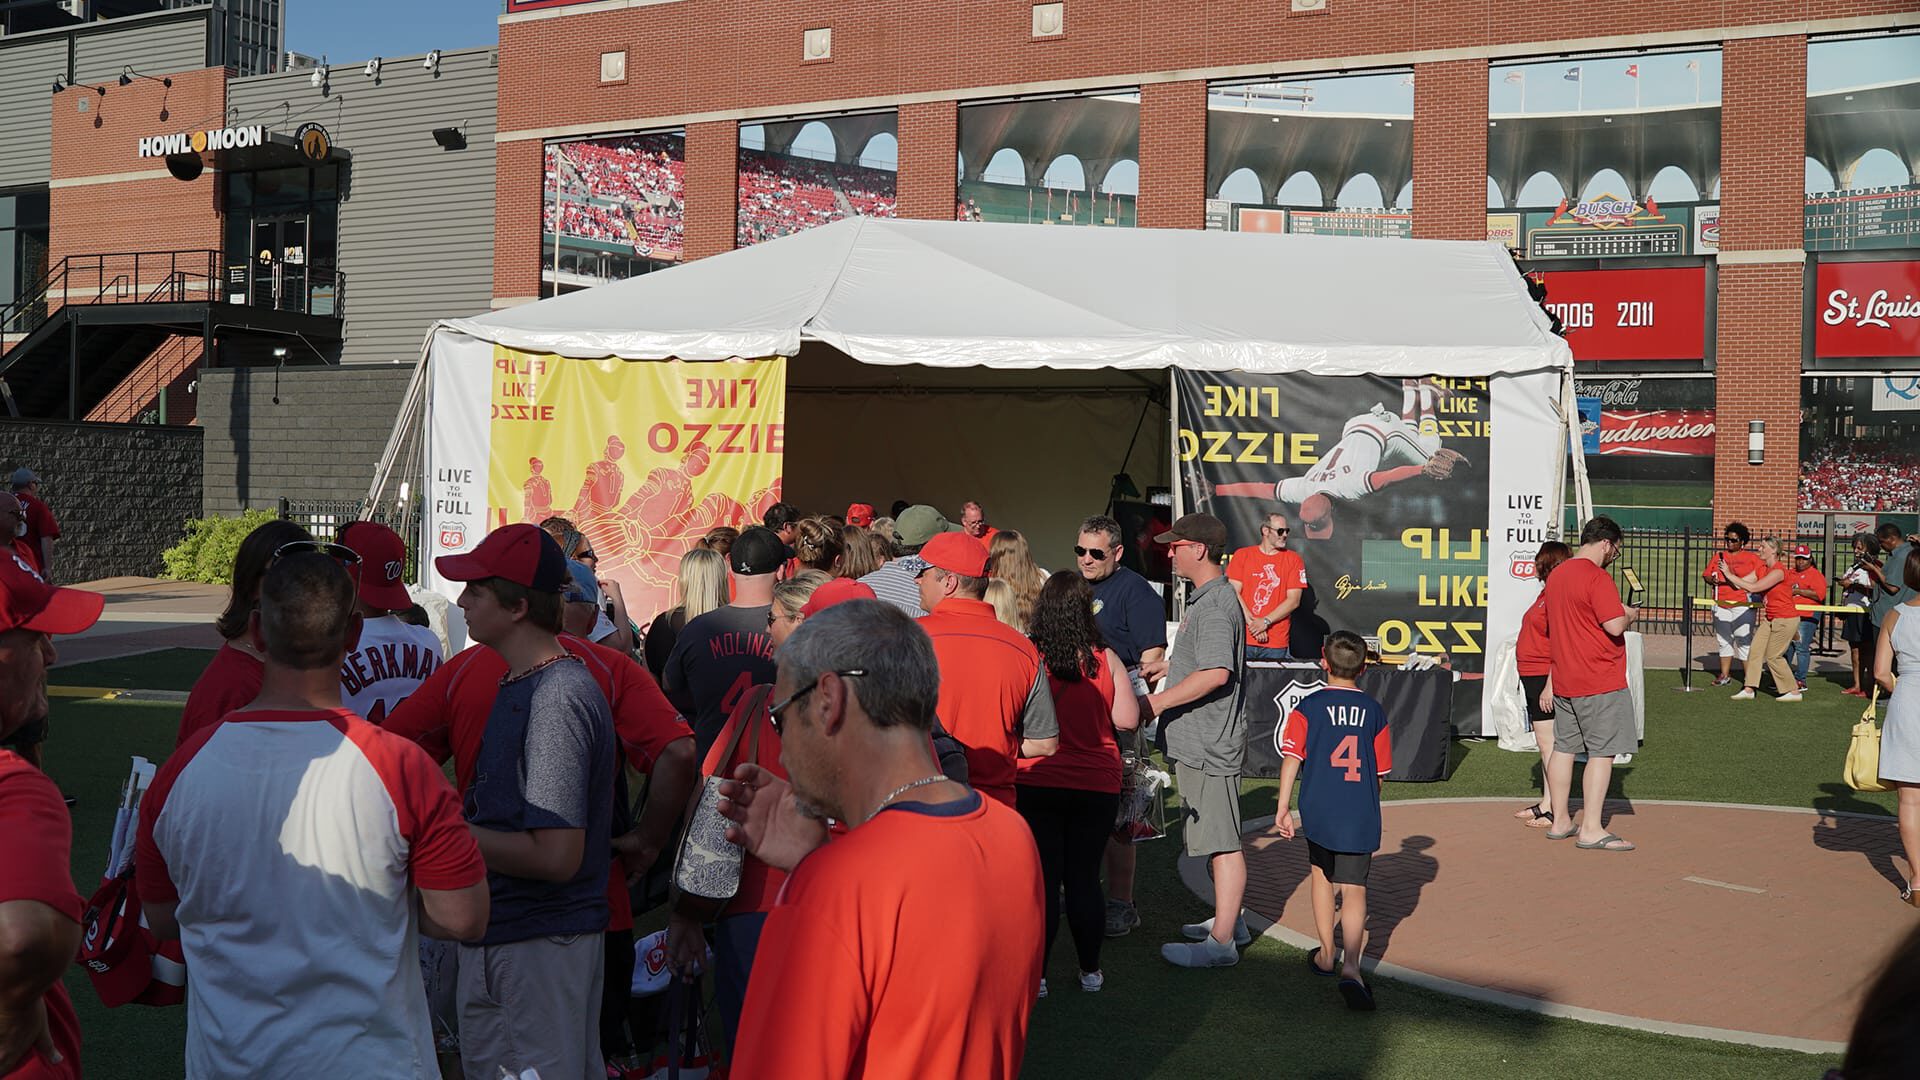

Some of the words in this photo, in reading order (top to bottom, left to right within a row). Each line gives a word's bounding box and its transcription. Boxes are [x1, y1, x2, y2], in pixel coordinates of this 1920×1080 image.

[138, 133, 191, 157] HOWL
[207, 125, 262, 150] MOON
[1807, 185, 1907, 200] NATIONAL
[1575, 201, 1637, 216] BUSCH
[1617, 301, 1654, 327] 2011
[502, 382, 537, 398] LIKE
[686, 378, 757, 409] LIKE
[1203, 385, 1280, 418] LIKE
[1440, 397, 1478, 413] LIKE
[647, 422, 785, 454] OZZIE
[1179, 428, 1320, 465] OZZIE
[438, 468, 472, 483] LIVE
[436, 500, 472, 515] FULL
[1508, 495, 1543, 510] LIVE
[442, 533, 460, 545] 66
[1506, 528, 1545, 543] FULL
[1515, 562, 1535, 574] 66
[1418, 575, 1489, 607] LIKE
[709, 631, 774, 662] MOLINA
[1326, 705, 1367, 728] YADI
[1330, 735, 1362, 782] 4
